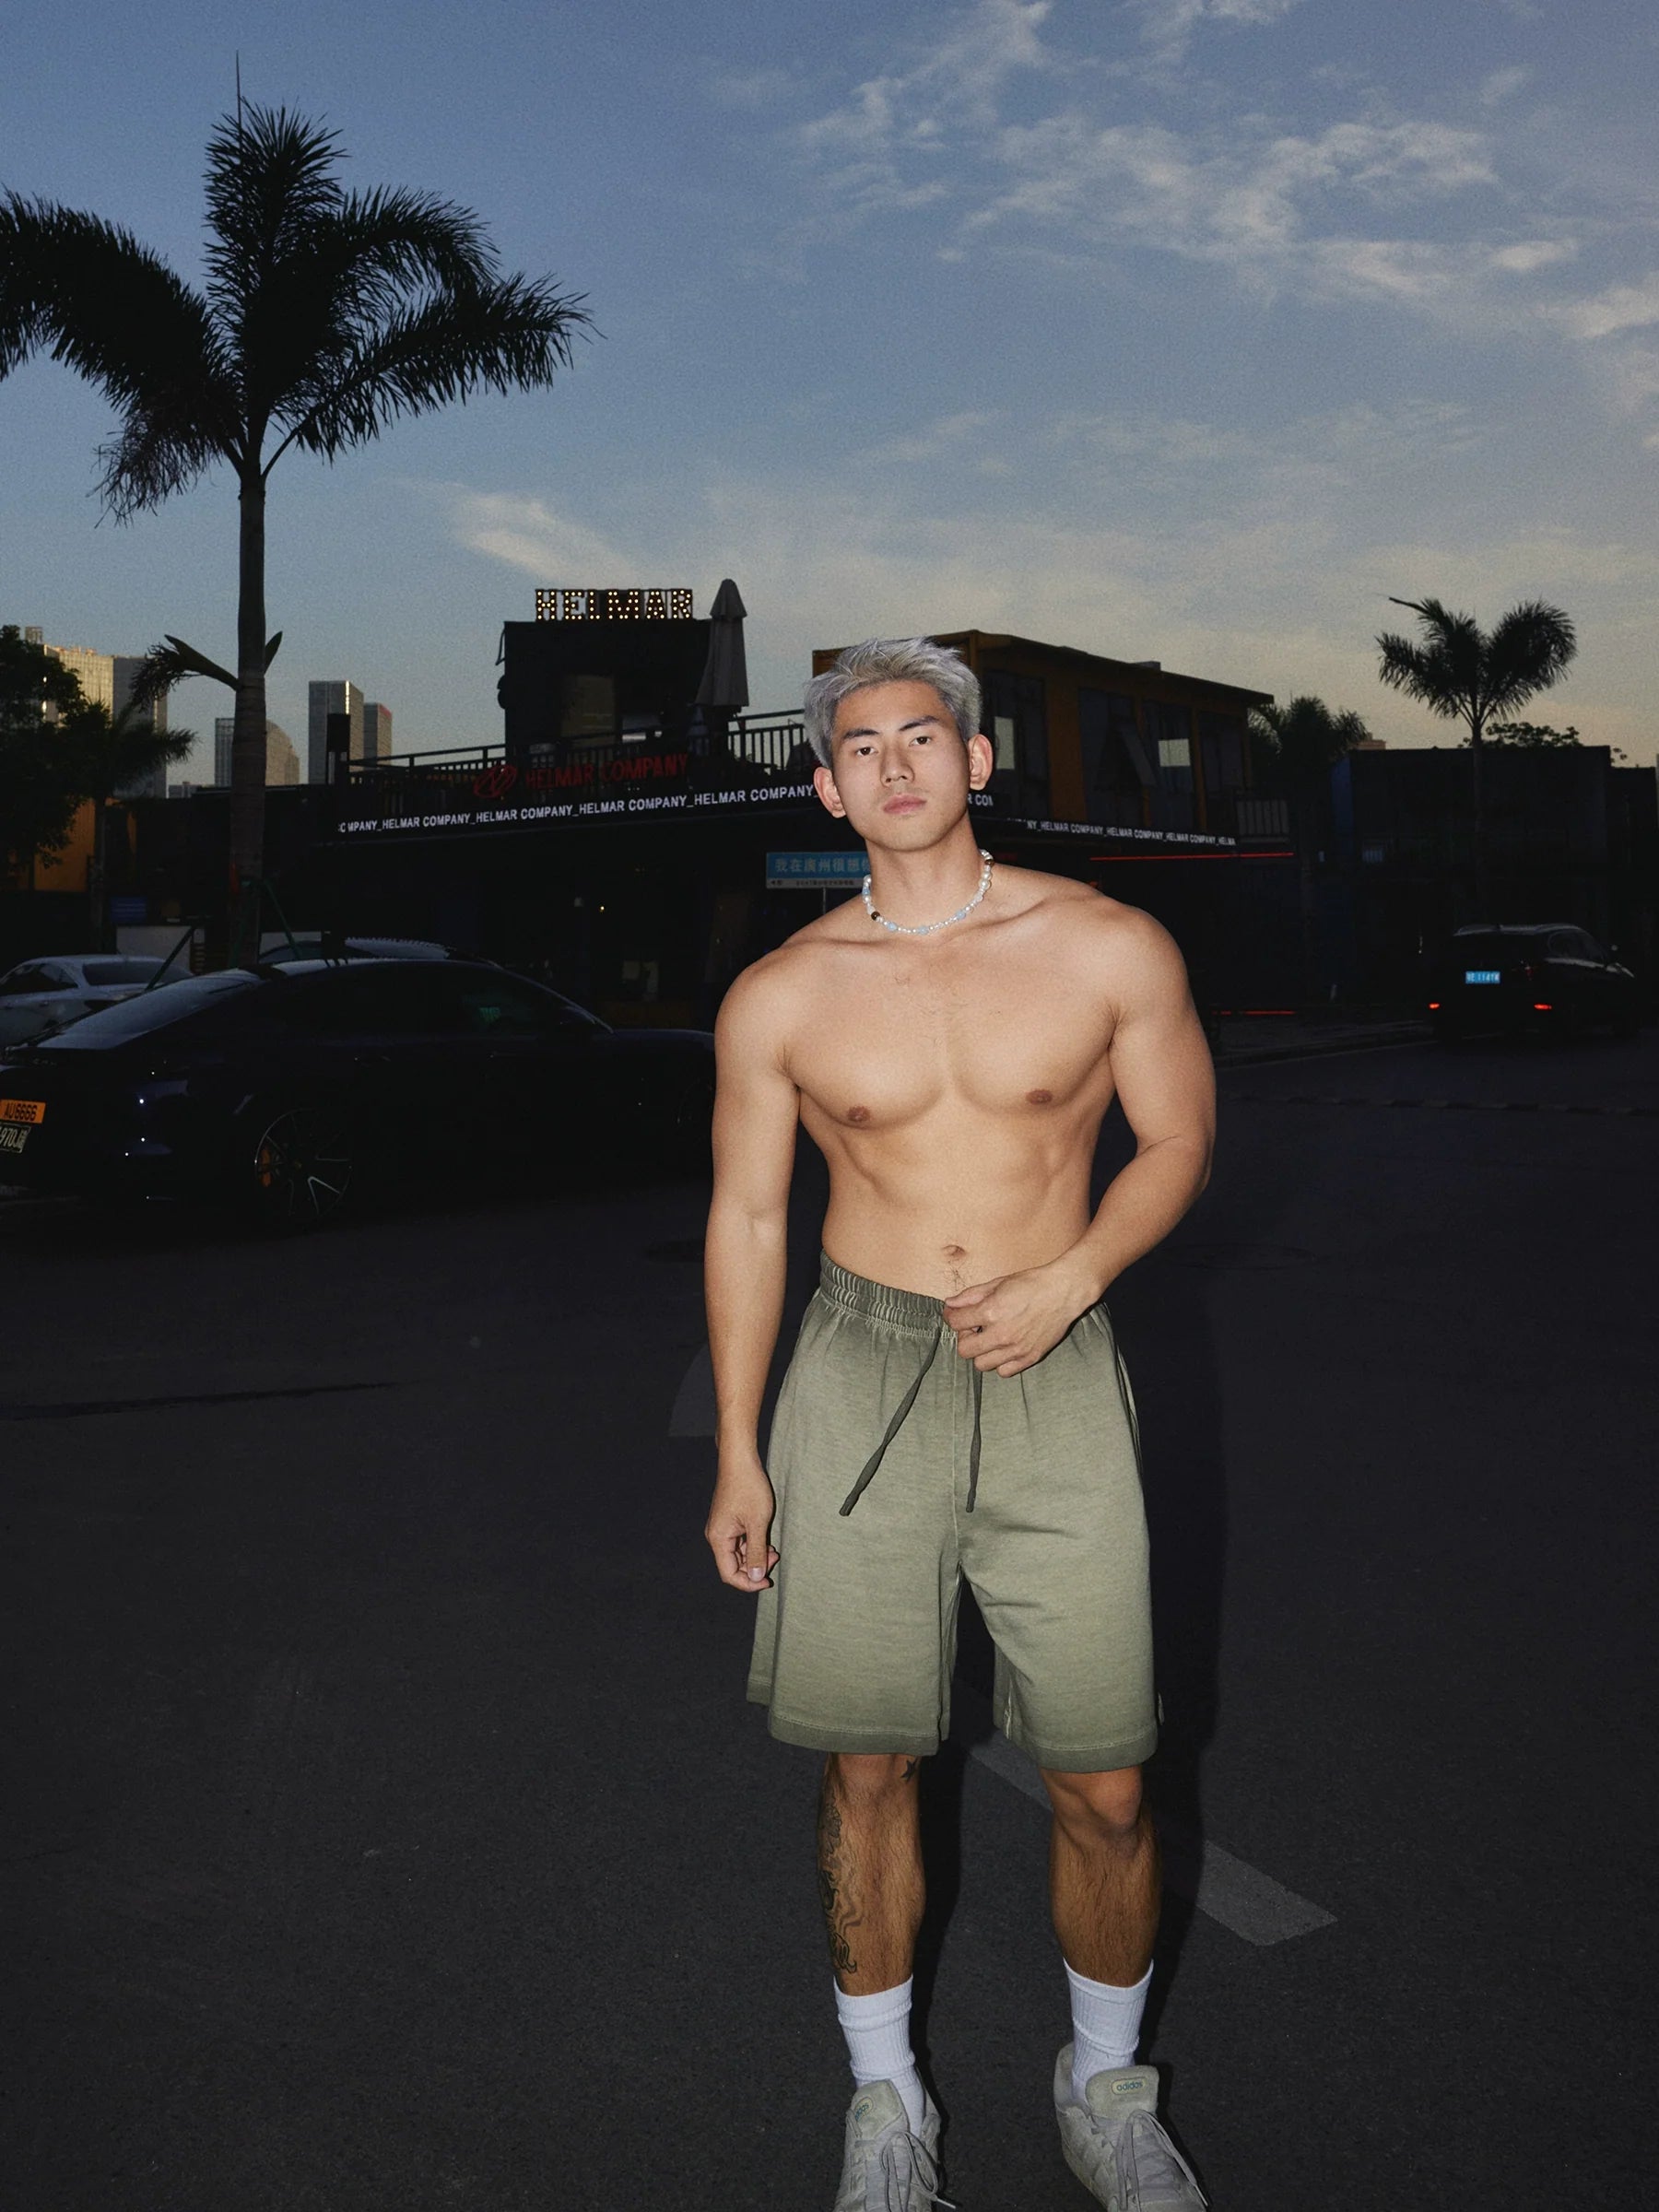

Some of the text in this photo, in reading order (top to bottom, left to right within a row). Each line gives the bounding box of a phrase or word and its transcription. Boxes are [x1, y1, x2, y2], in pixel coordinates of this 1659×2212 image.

[535, 589, 692, 620] HELMAR
[525, 752, 688, 790] HELMAR COMPANY
[1116, 2081, 1143, 2092] adidas
